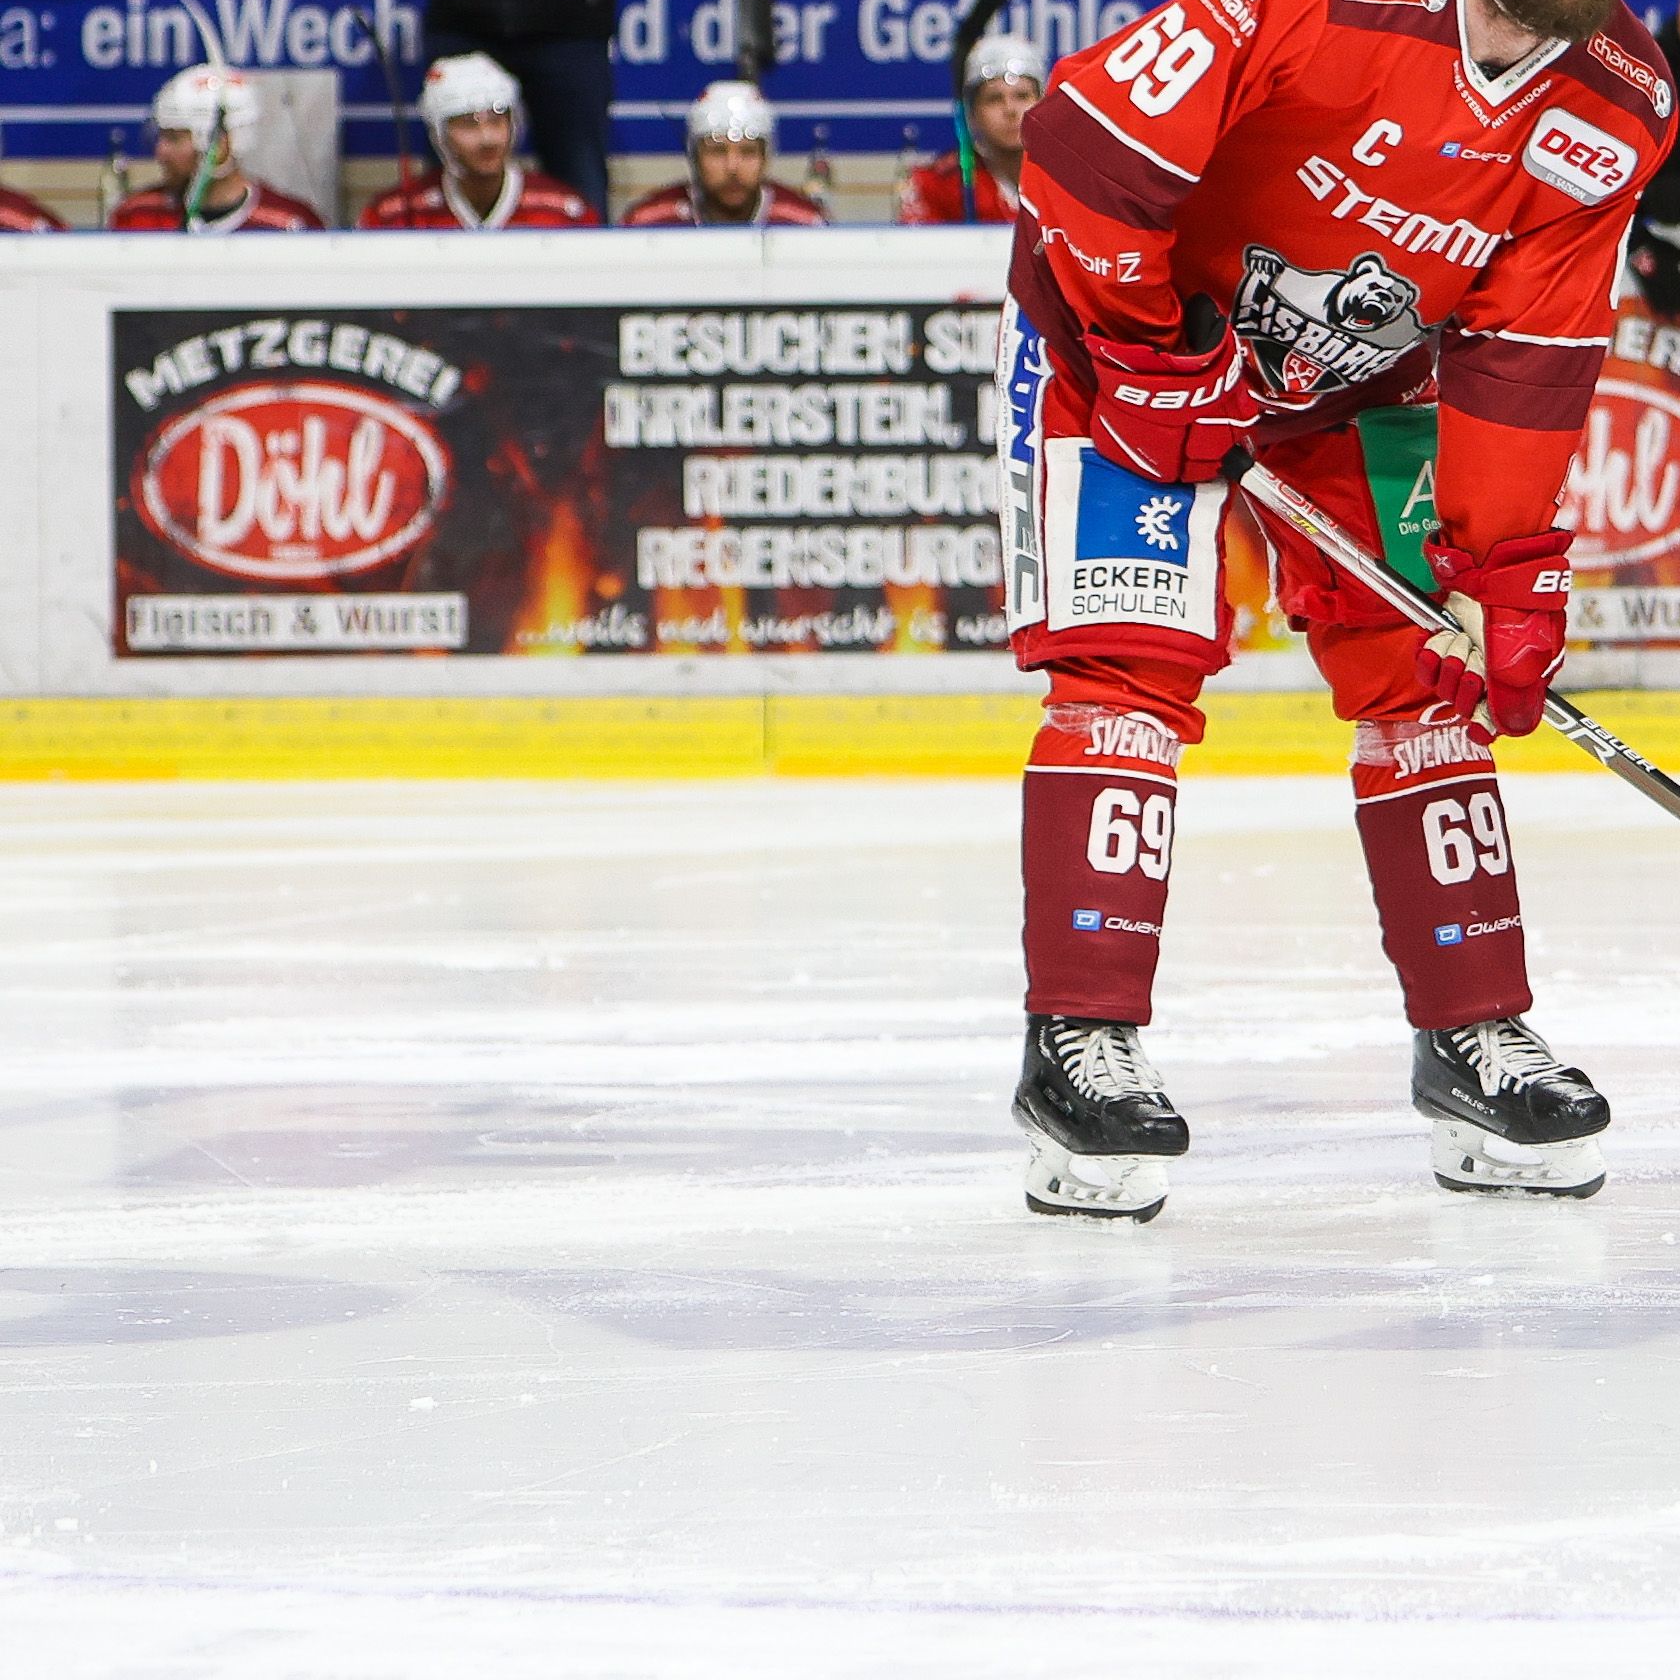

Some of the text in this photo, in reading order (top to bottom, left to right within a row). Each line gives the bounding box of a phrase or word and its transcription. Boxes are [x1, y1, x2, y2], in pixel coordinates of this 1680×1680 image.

[1103, 2, 1215, 118] 69
[1351, 118, 1403, 167] C
[124, 319, 465, 413] METZGEREI
[619, 311, 915, 377] BESUCHEN
[198, 414, 398, 547] Döhl
[683, 453, 1000, 519] RIEDENBUR
[1071, 593, 1187, 619] SCHULEN
[1073, 566, 1189, 594] ECKERT
[337, 603, 460, 637] Wurst
[1580, 716, 1657, 773] BAUER
[1086, 786, 1174, 882] 69
[1421, 792, 1509, 886] 69
